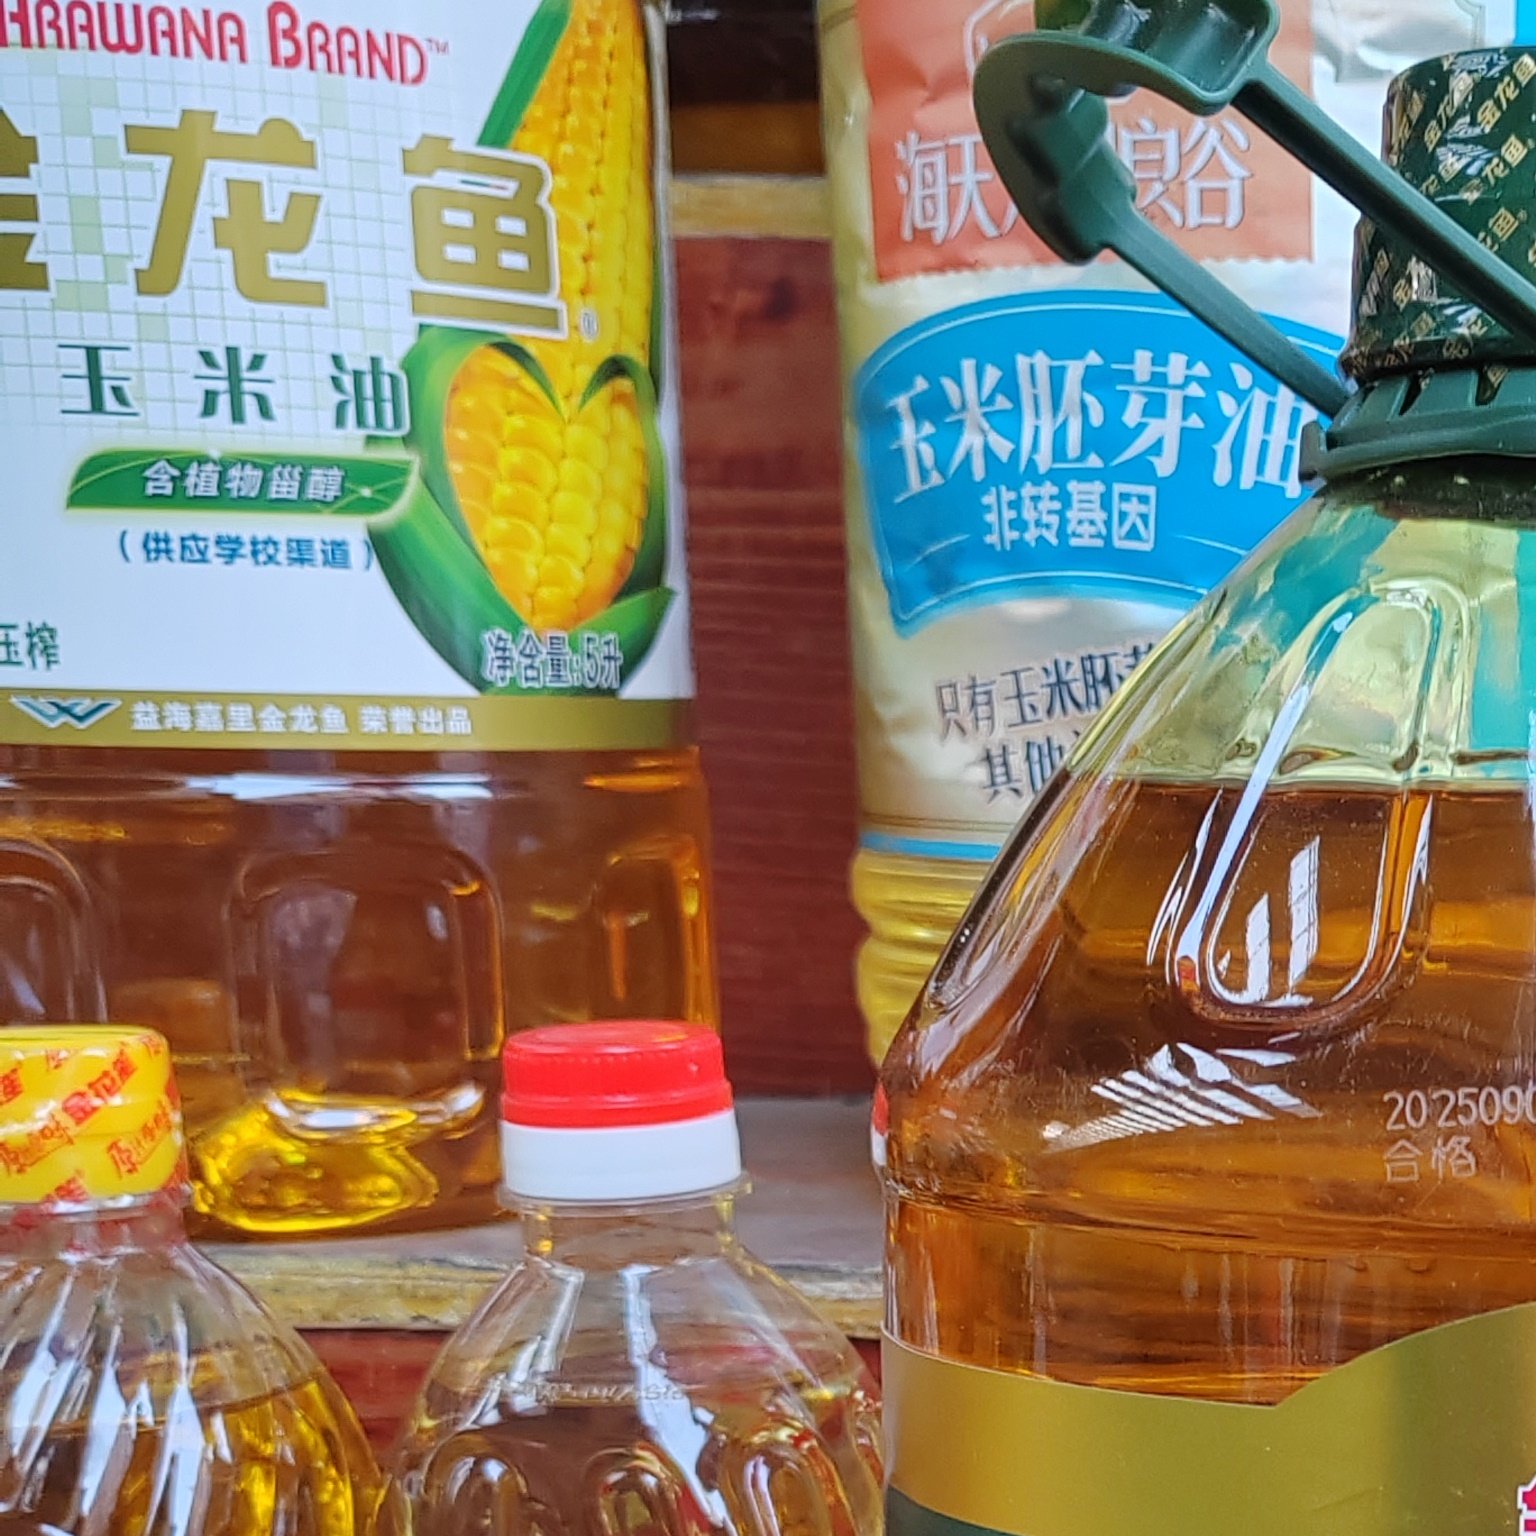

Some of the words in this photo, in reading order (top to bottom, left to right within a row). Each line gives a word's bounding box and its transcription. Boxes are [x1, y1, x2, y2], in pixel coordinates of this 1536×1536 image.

[0, 108, 564, 335] 龙鱼
[61, 344, 410, 432] 玉米油
[887, 348, 1318, 502] 玉米胚芽油
[980, 480, 1157, 551] 非转基因
[1383, 1136, 1478, 1184] 合格
